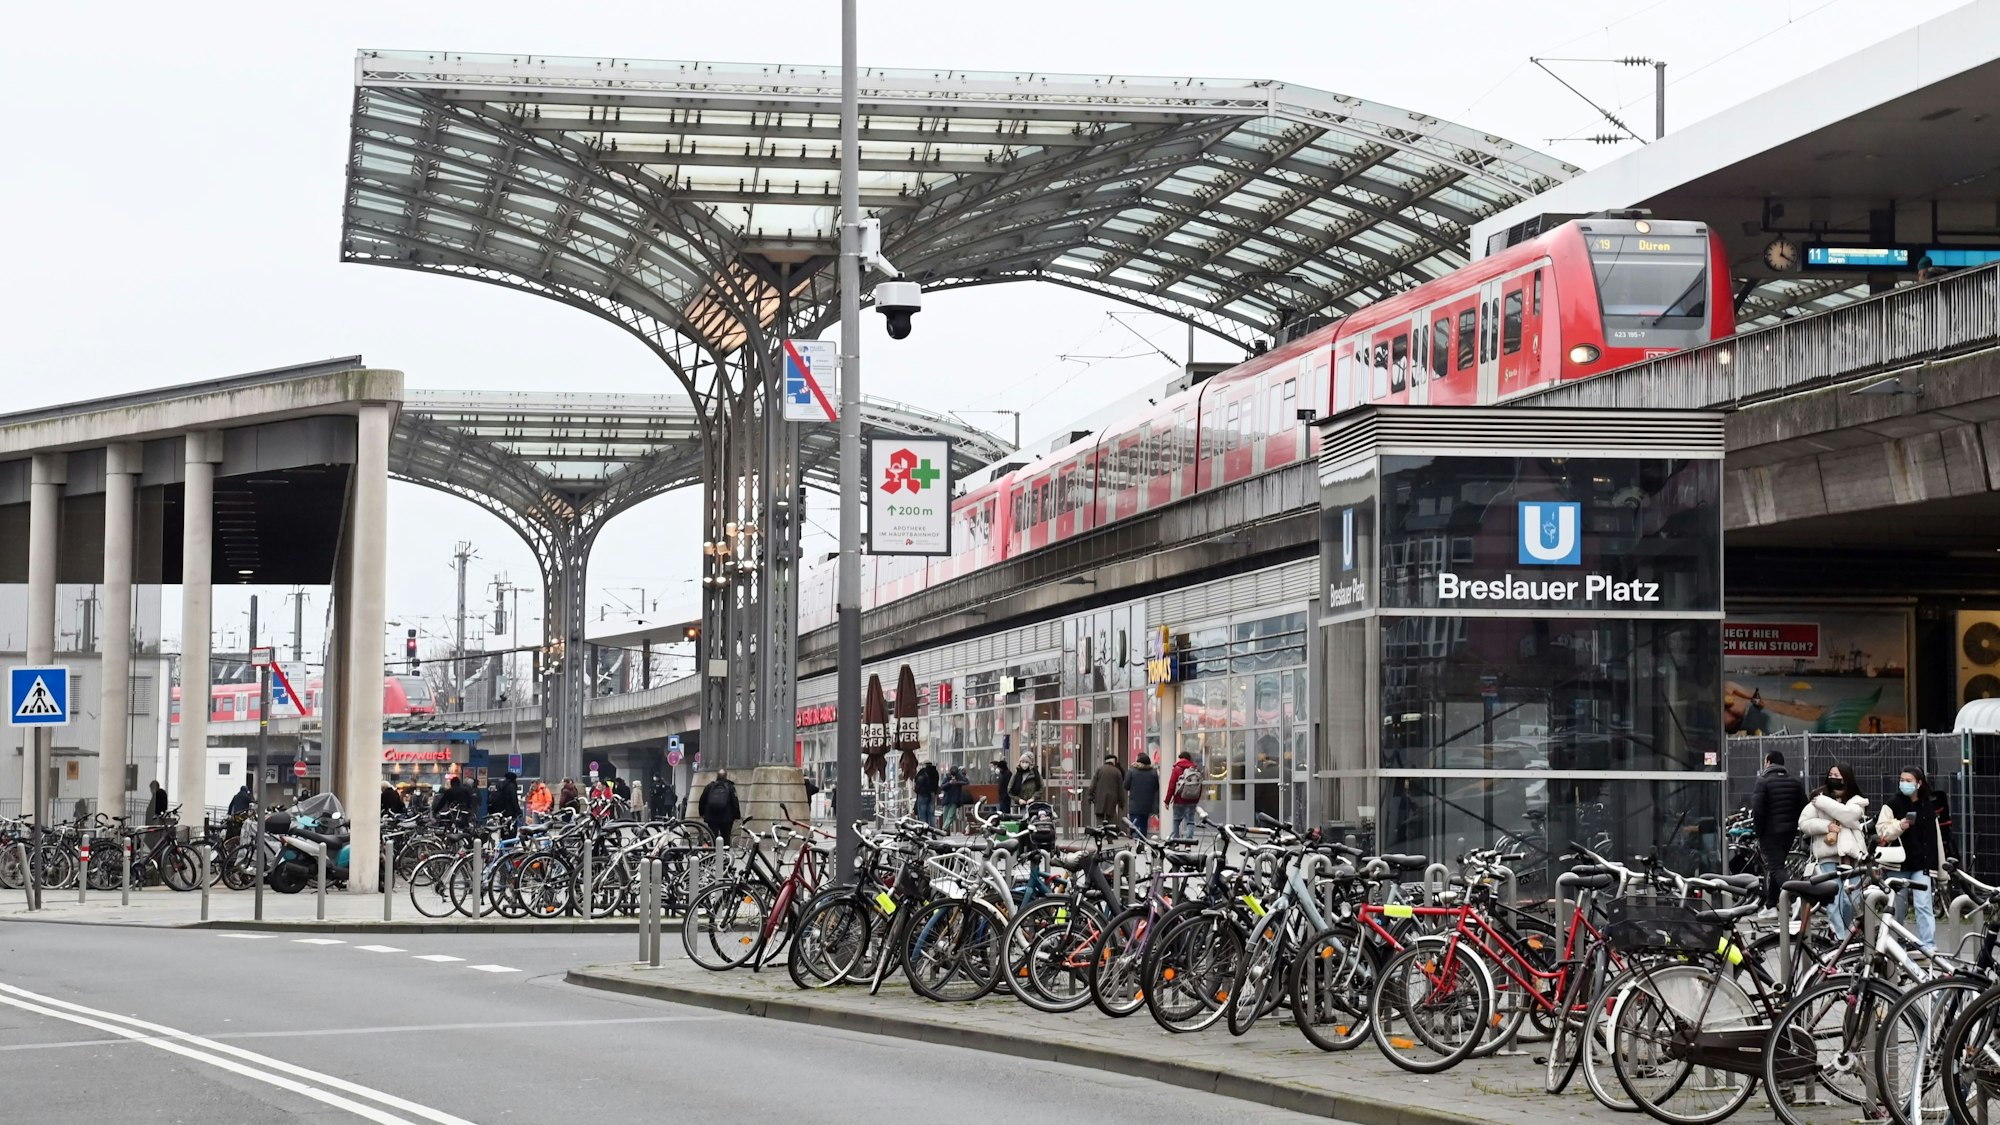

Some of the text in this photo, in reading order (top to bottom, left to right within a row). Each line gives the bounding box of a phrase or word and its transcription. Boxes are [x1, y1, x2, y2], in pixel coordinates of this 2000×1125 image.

[1809, 248, 1821, 260] 11
[899, 506, 933, 516] 200 m
[1343, 511, 1353, 566] U
[1525, 505, 1575, 561] U
[1330, 577, 1365, 608] Breslauer Platz
[1438, 573, 1659, 602] Breslauer Platz
[1752, 629, 1780, 639] HIER
[1739, 641, 1767, 651] KEIN
[1769, 641, 1814, 651] STROH?
[383, 747, 452, 762] Currywurst
